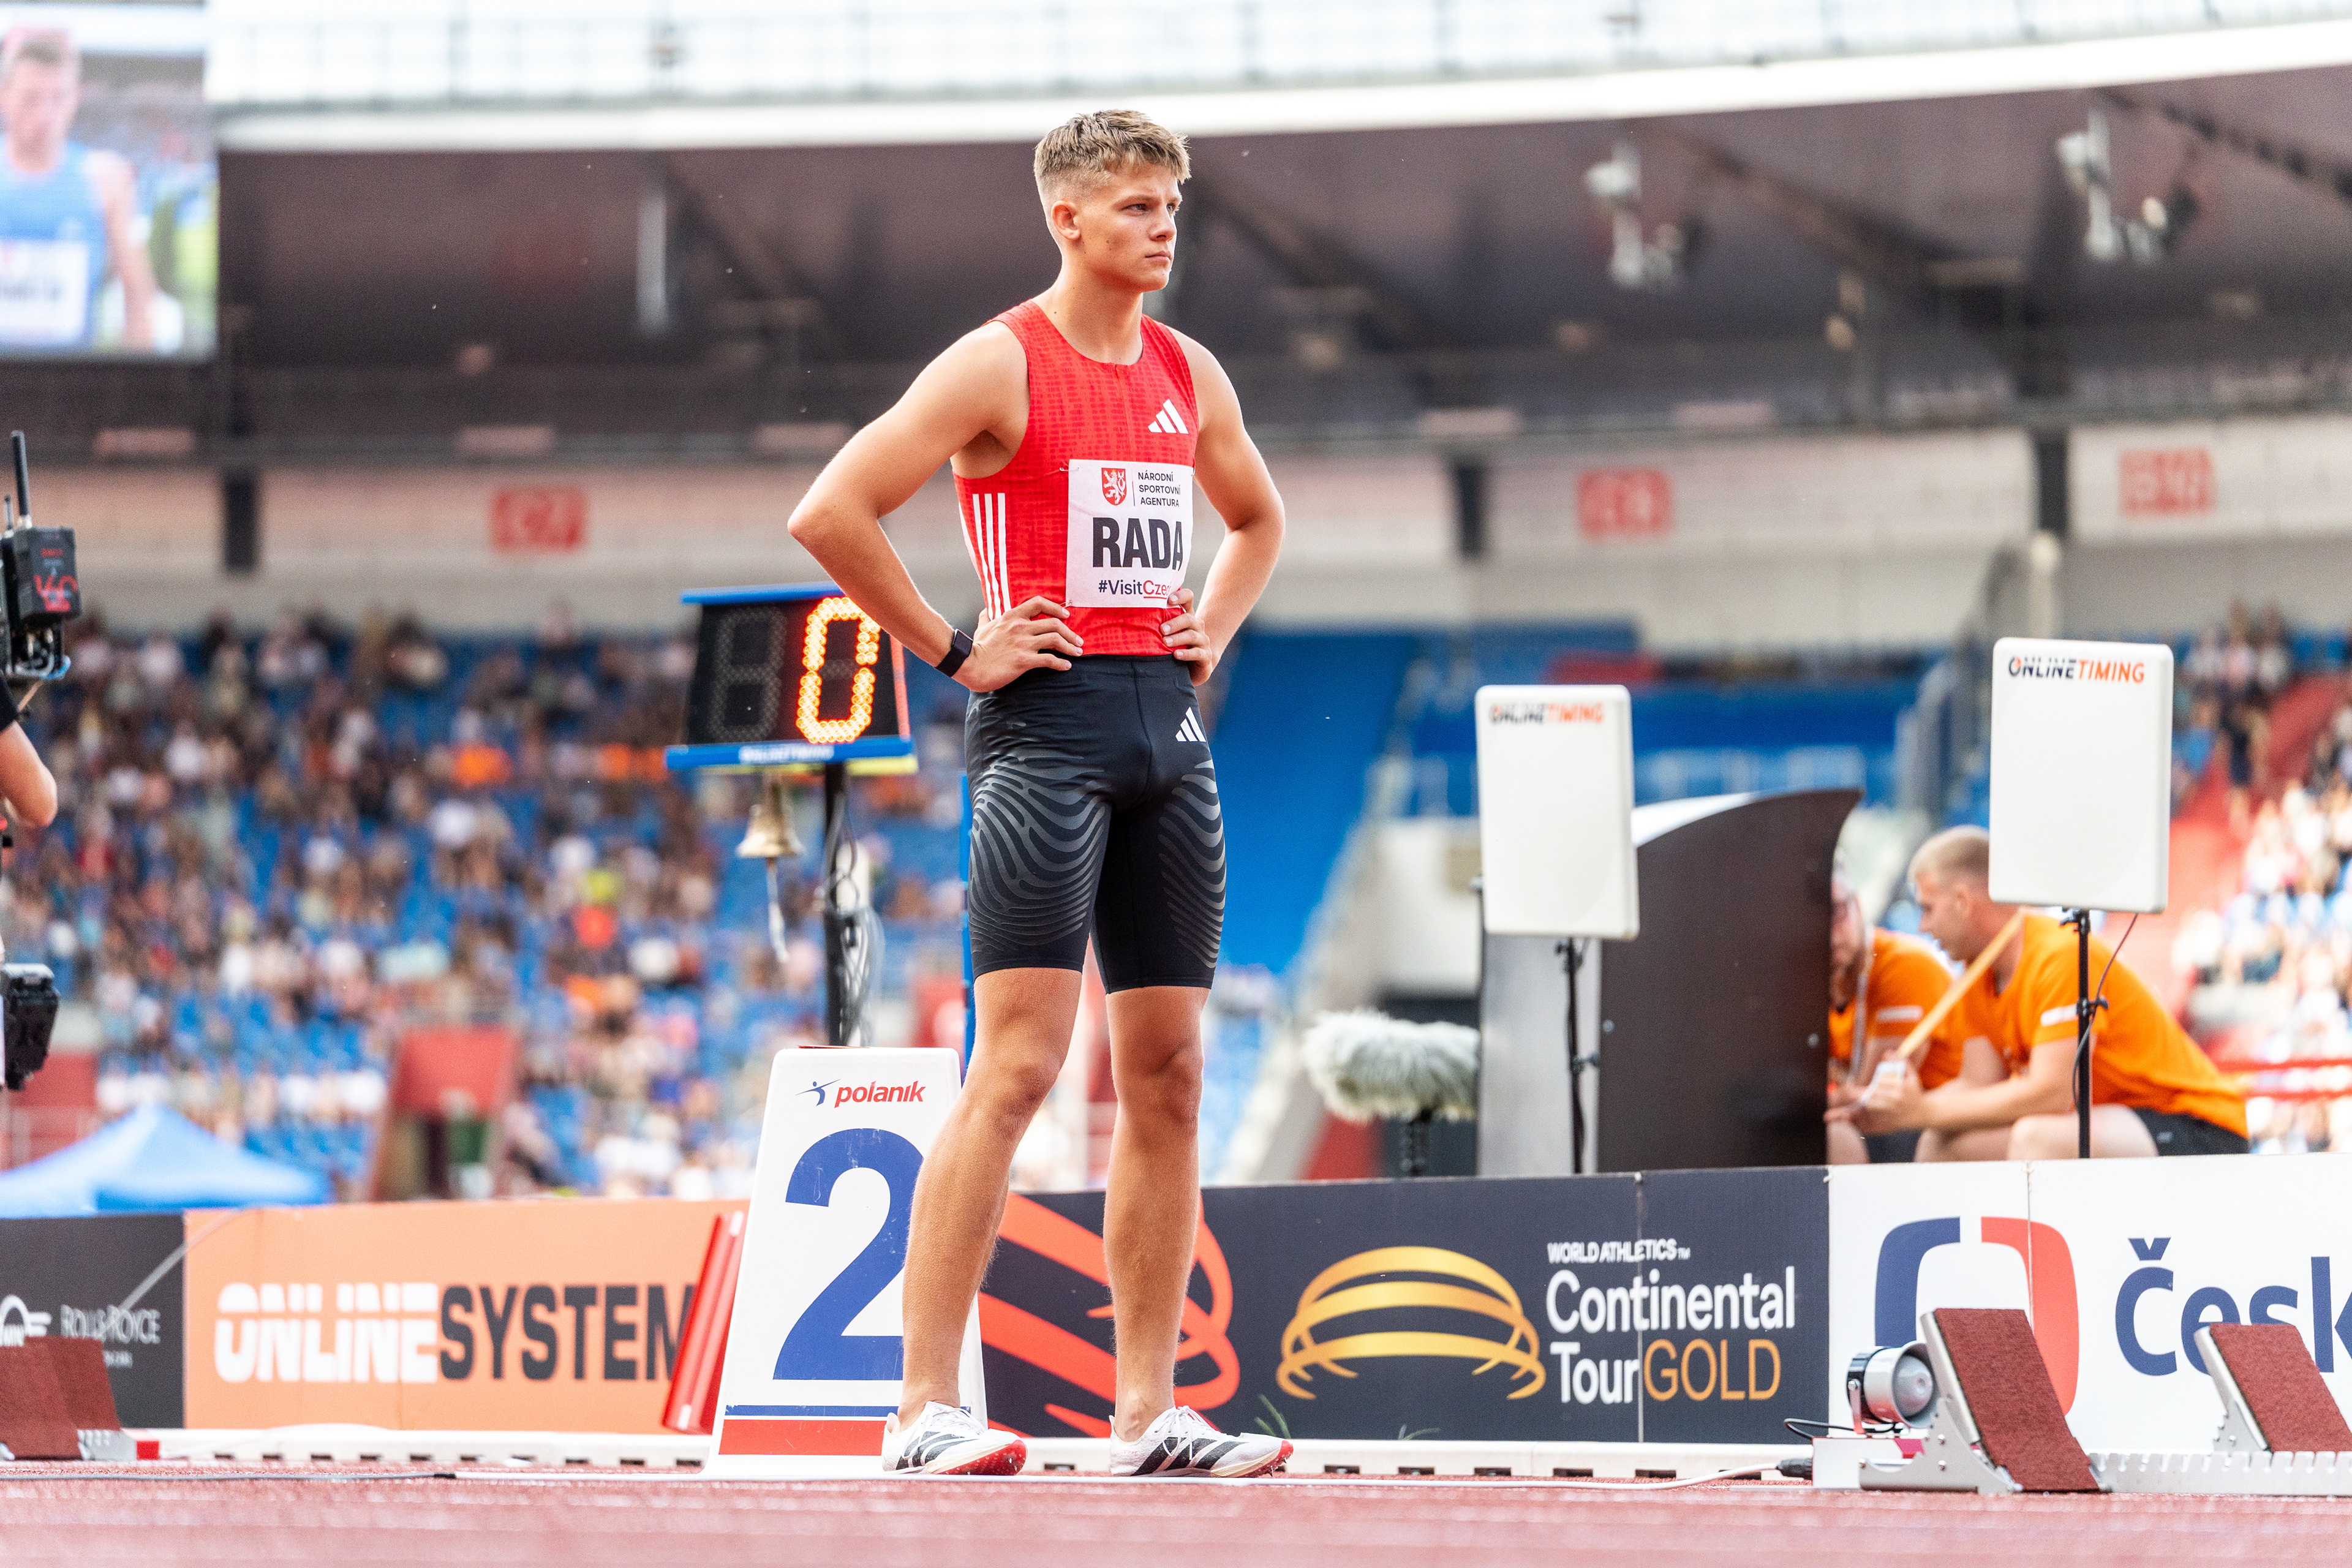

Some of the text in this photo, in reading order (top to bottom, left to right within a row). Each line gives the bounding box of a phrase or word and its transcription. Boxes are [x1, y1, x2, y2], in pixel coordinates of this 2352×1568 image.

[1137, 469, 1174, 481] NÁRODNÍ
[1139, 484, 1181, 495] SPORTOVNÍ
[1140, 497, 1180, 508] AGENTURA
[1092, 517, 1184, 571] RADA
[796, 597, 881, 744] 0
[2008, 656, 2144, 684] ONLINETIMING
[834, 1080, 927, 1109] polanik
[772, 1128, 925, 1381] 2
[1547, 1241, 1600, 1264] WORLD
[1599, 1238, 1678, 1264] ATHLETICS
[1545, 1265, 1796, 1334] Continental
[1550, 1338, 1782, 1404] Tour GOLD
